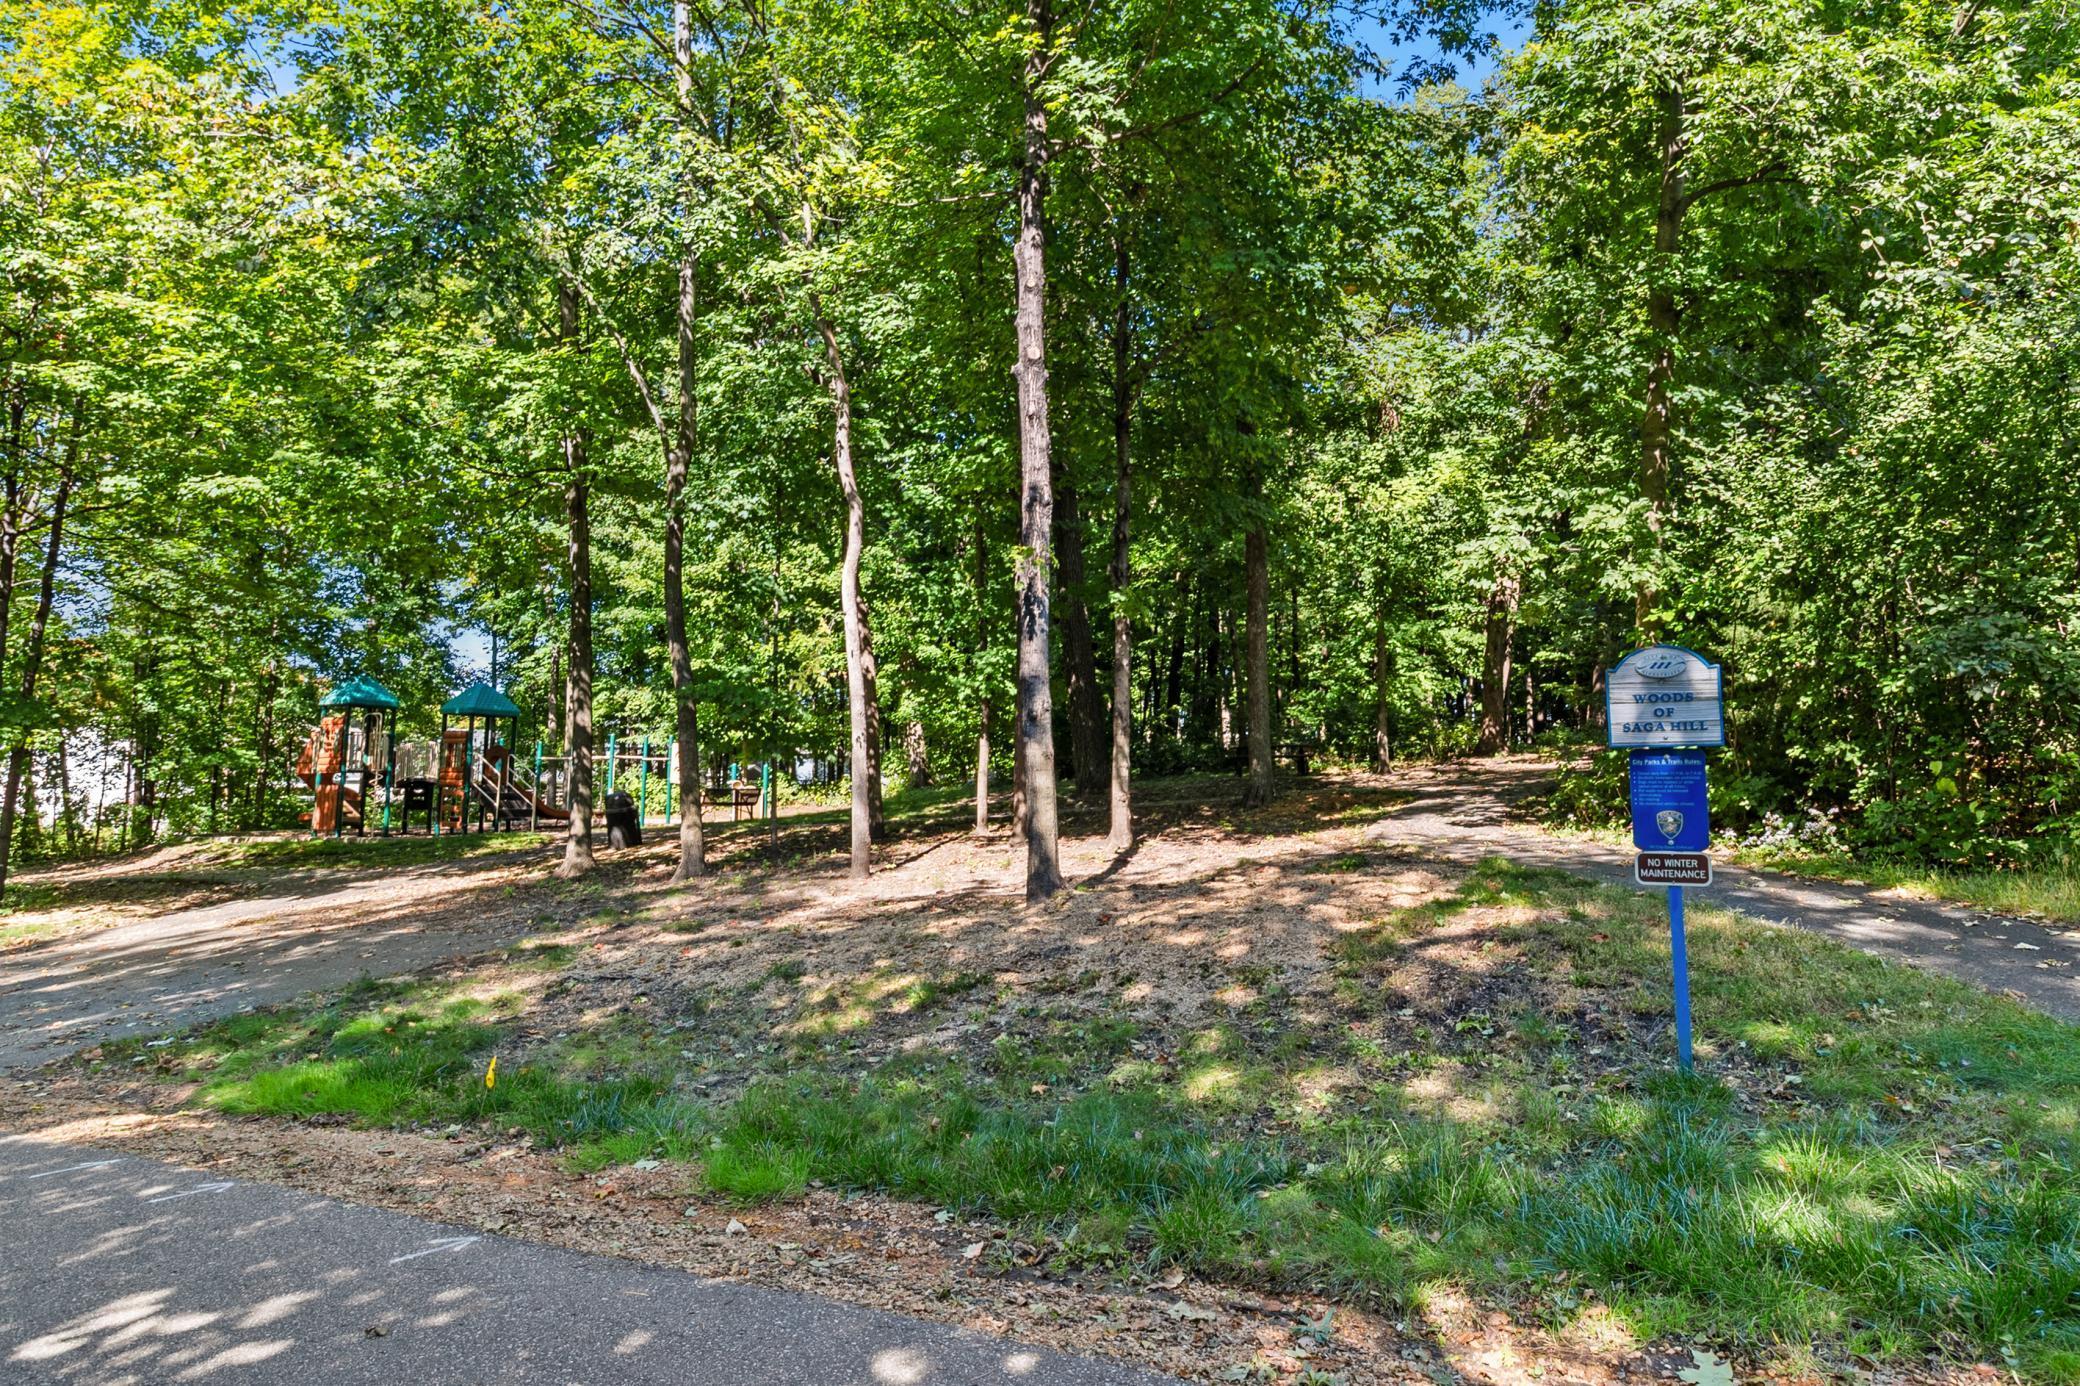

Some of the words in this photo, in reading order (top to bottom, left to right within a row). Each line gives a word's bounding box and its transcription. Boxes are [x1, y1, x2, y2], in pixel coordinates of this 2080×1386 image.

[1632, 692, 1694, 704] WOODS
[1654, 708, 1674, 717] OF
[1623, 722, 1665, 732] SAGA
[1670, 720, 1708, 730] HILL
[1648, 858, 1660, 867] NO
[1664, 859, 1698, 868] WINTER
[1640, 869, 1706, 878] MAINTENANCE
